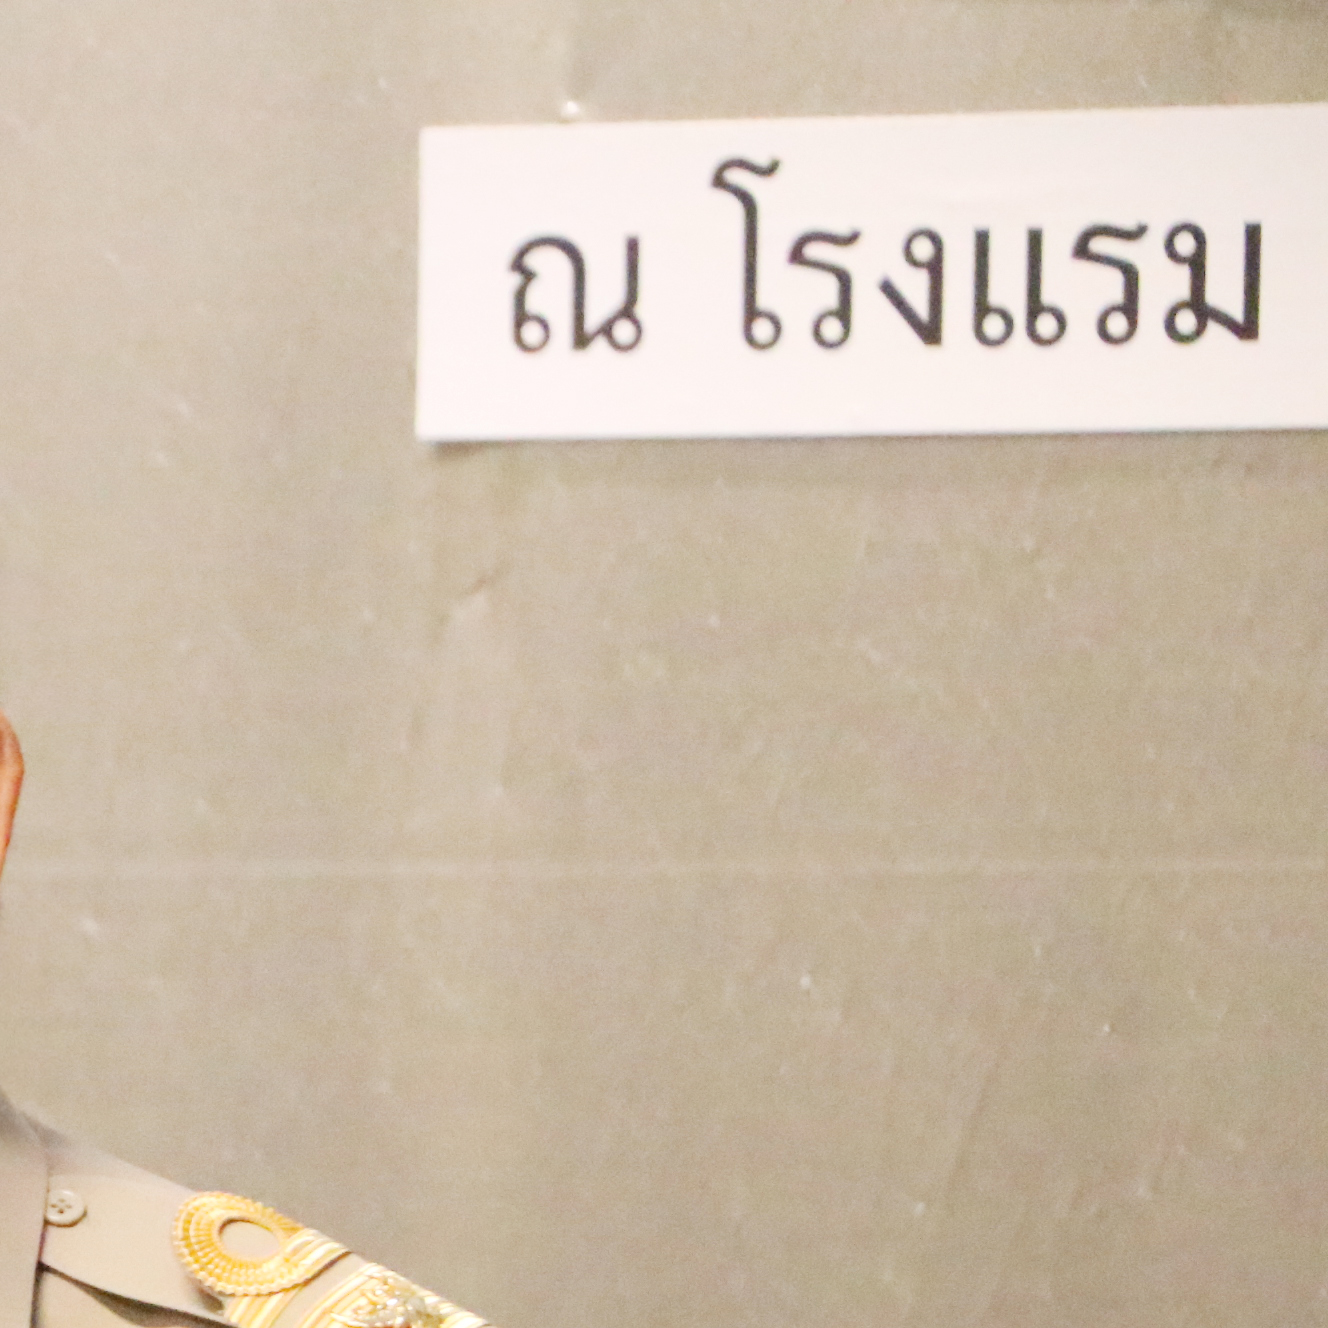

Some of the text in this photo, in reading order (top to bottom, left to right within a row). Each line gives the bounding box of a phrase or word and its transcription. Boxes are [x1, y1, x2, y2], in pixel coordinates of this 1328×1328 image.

[508, 157, 1264, 354] ณ โรงแรม
